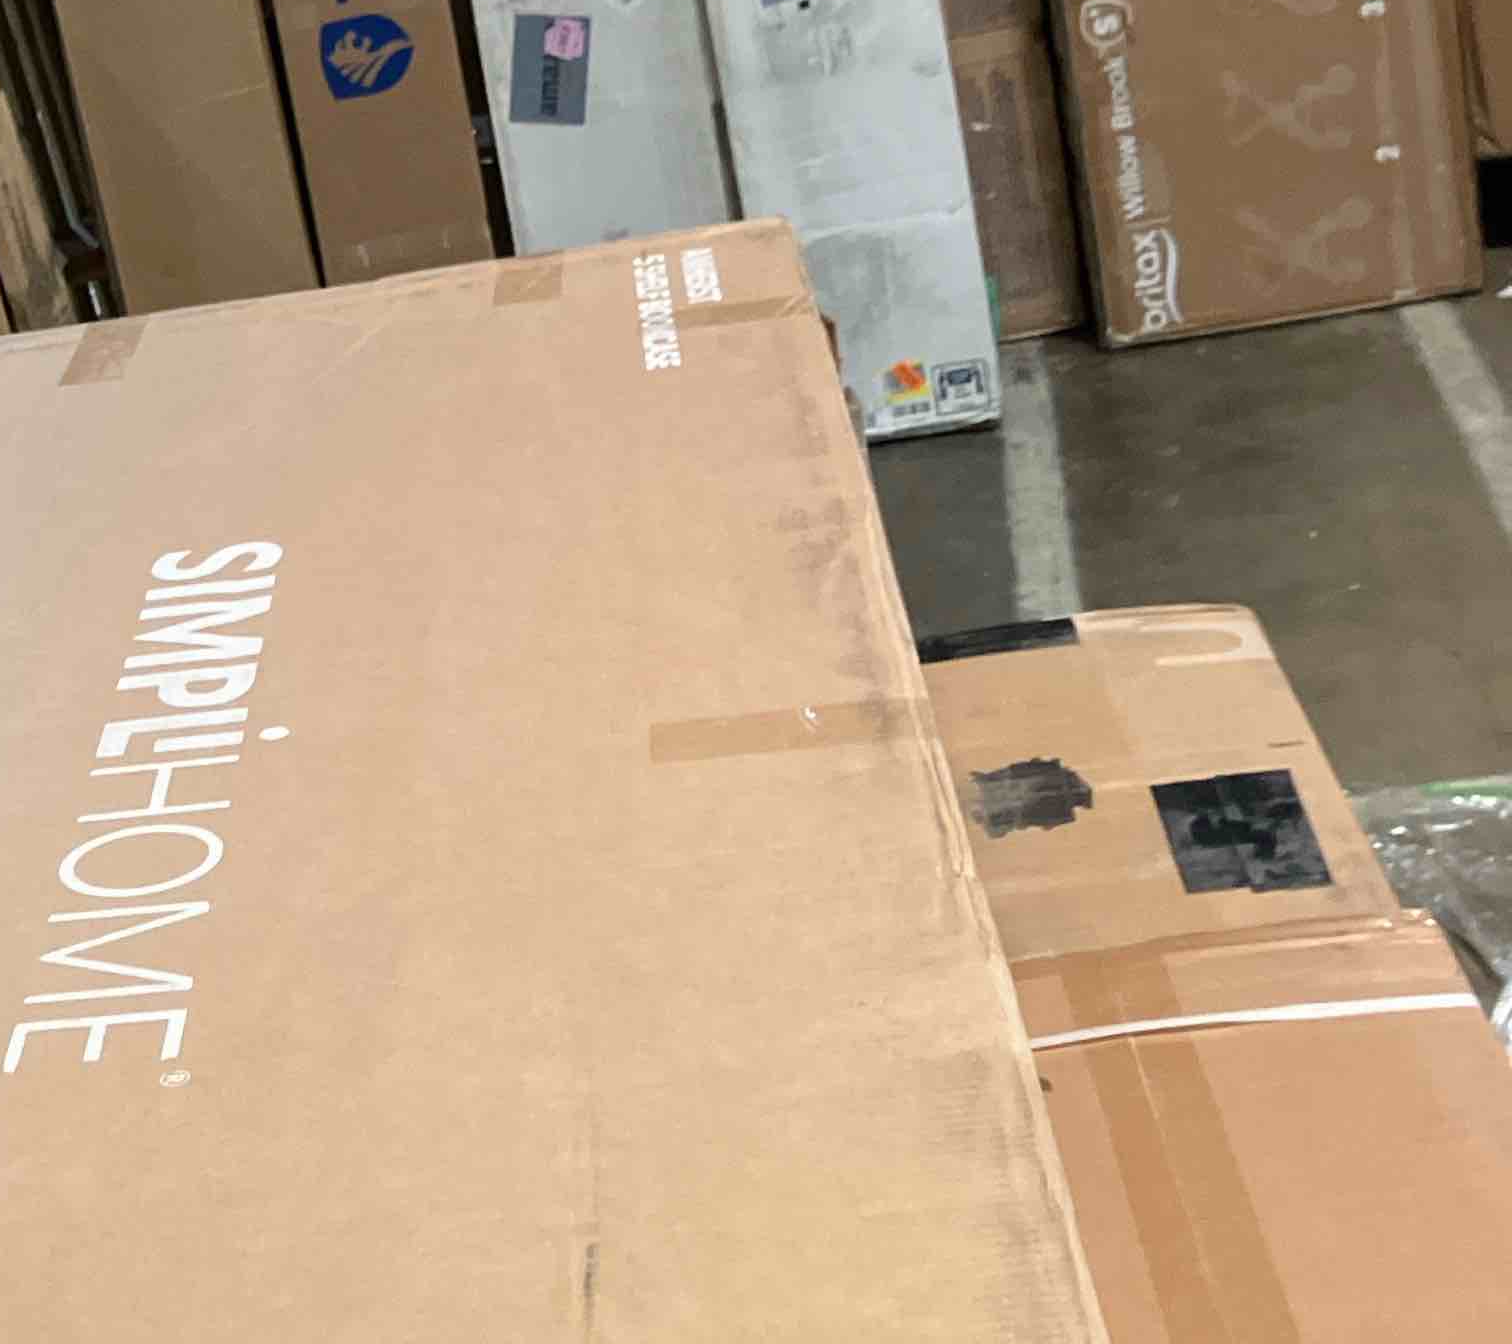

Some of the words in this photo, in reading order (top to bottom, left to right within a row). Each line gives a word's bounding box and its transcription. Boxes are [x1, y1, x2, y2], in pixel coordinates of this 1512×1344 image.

[1103, 56, 1136, 131] Brook
[1116, 134, 1145, 222] Willow
[1132, 232, 1170, 334] britax
